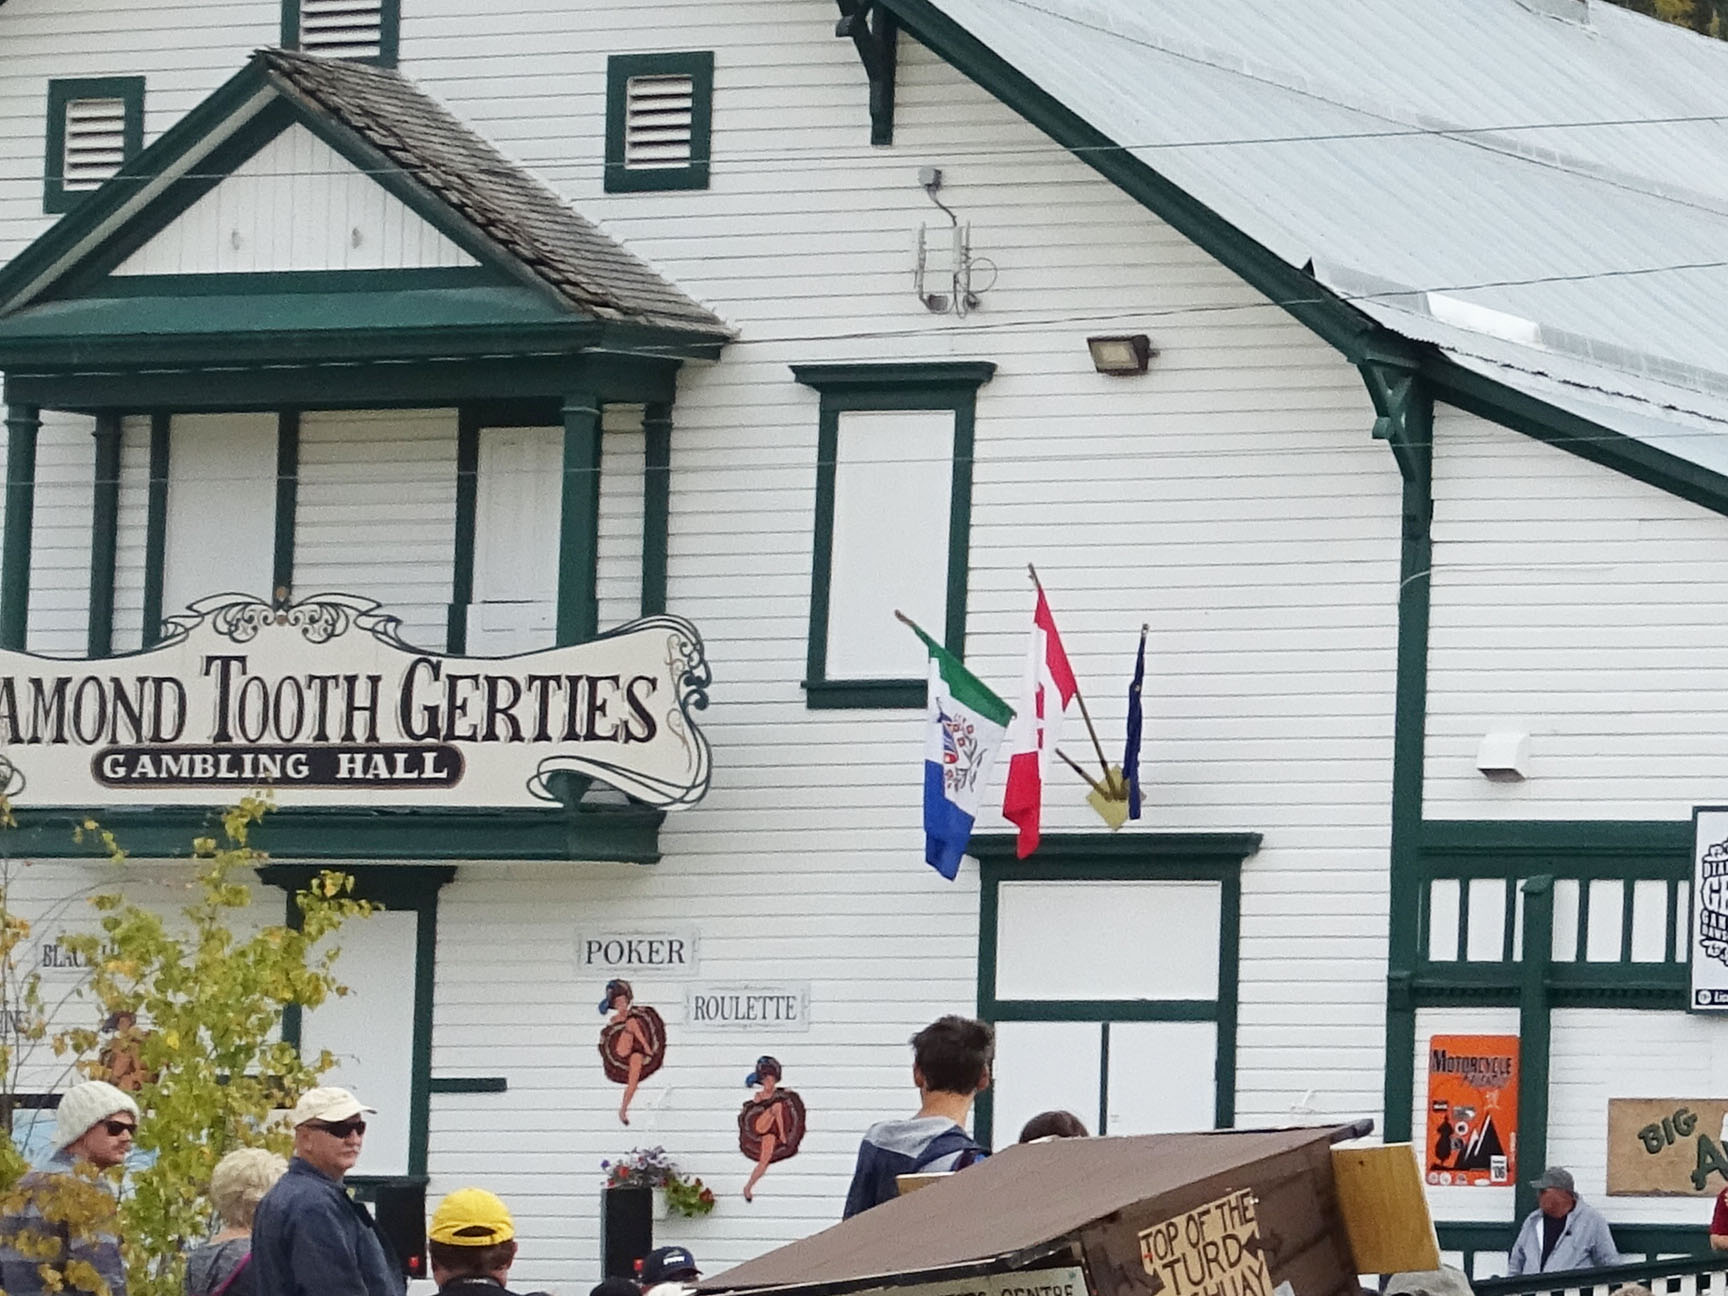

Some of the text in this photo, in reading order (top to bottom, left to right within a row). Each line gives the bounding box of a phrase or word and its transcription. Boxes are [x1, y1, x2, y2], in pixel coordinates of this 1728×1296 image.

[203, 655, 382, 744] TOOTH
[400, 656, 660, 745] GERTIES
[103, 752, 448, 780] GAMBLING HALL
[585, 938, 686, 966] POKER
[694, 995, 798, 1021] ROULETTE
[1637, 1106, 1699, 1155] BIG
[1140, 1192, 1256, 1264] TOP OF THE
[1163, 1233, 1244, 1296] TURD
